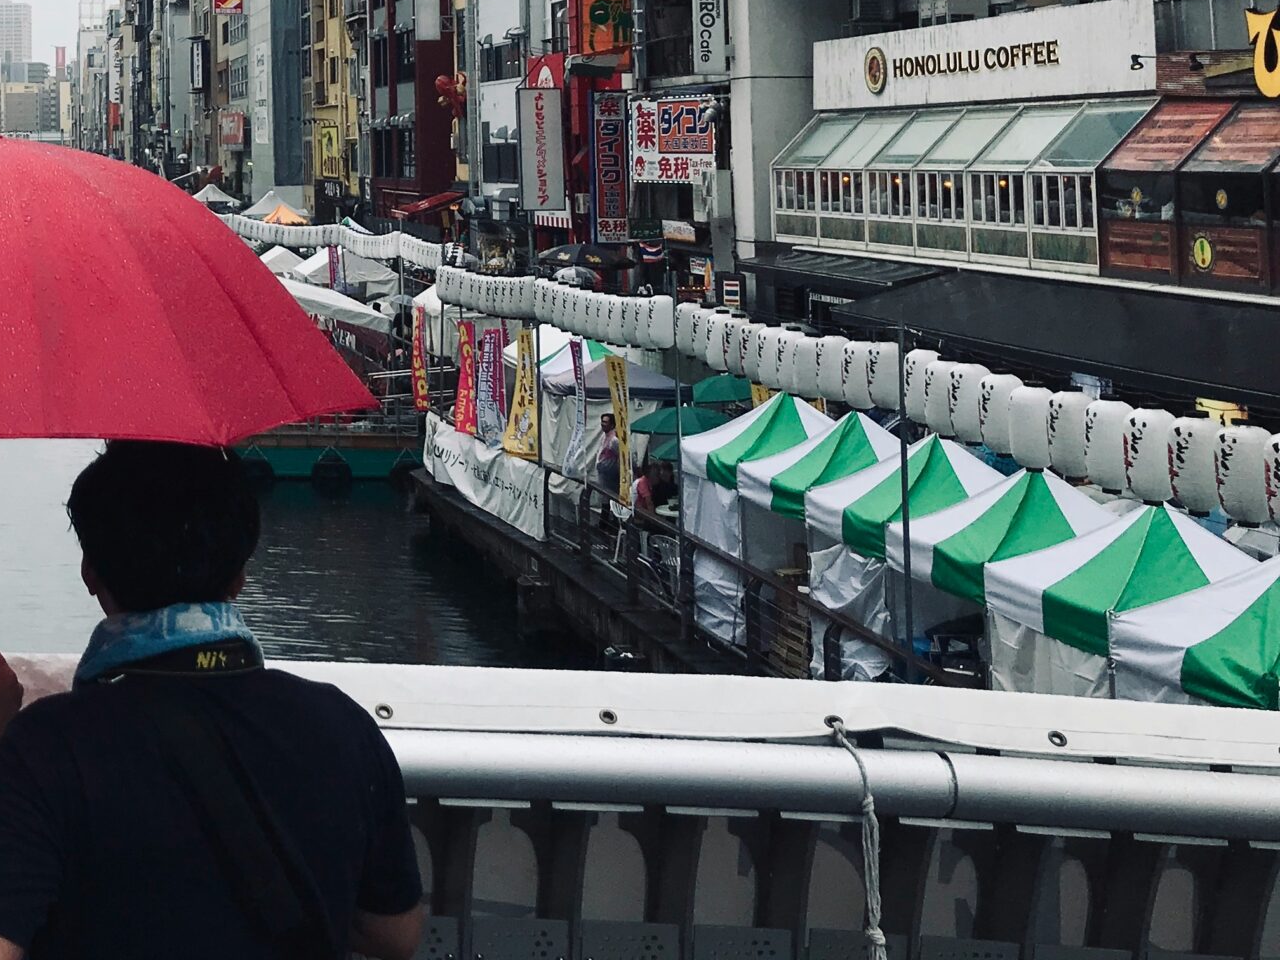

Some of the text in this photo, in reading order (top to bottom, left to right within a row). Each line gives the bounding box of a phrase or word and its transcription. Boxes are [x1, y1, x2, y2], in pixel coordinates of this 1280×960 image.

[892, 39, 1061, 79] HONOLULU COFFEE
[636, 102, 657, 149] 薬
[660, 104, 710, 136] ダイコク
[599, 120, 622, 185] ダイコク
[657, 156, 713, 180] 免税 Tax-Free
[598, 219, 627, 233] 免税
